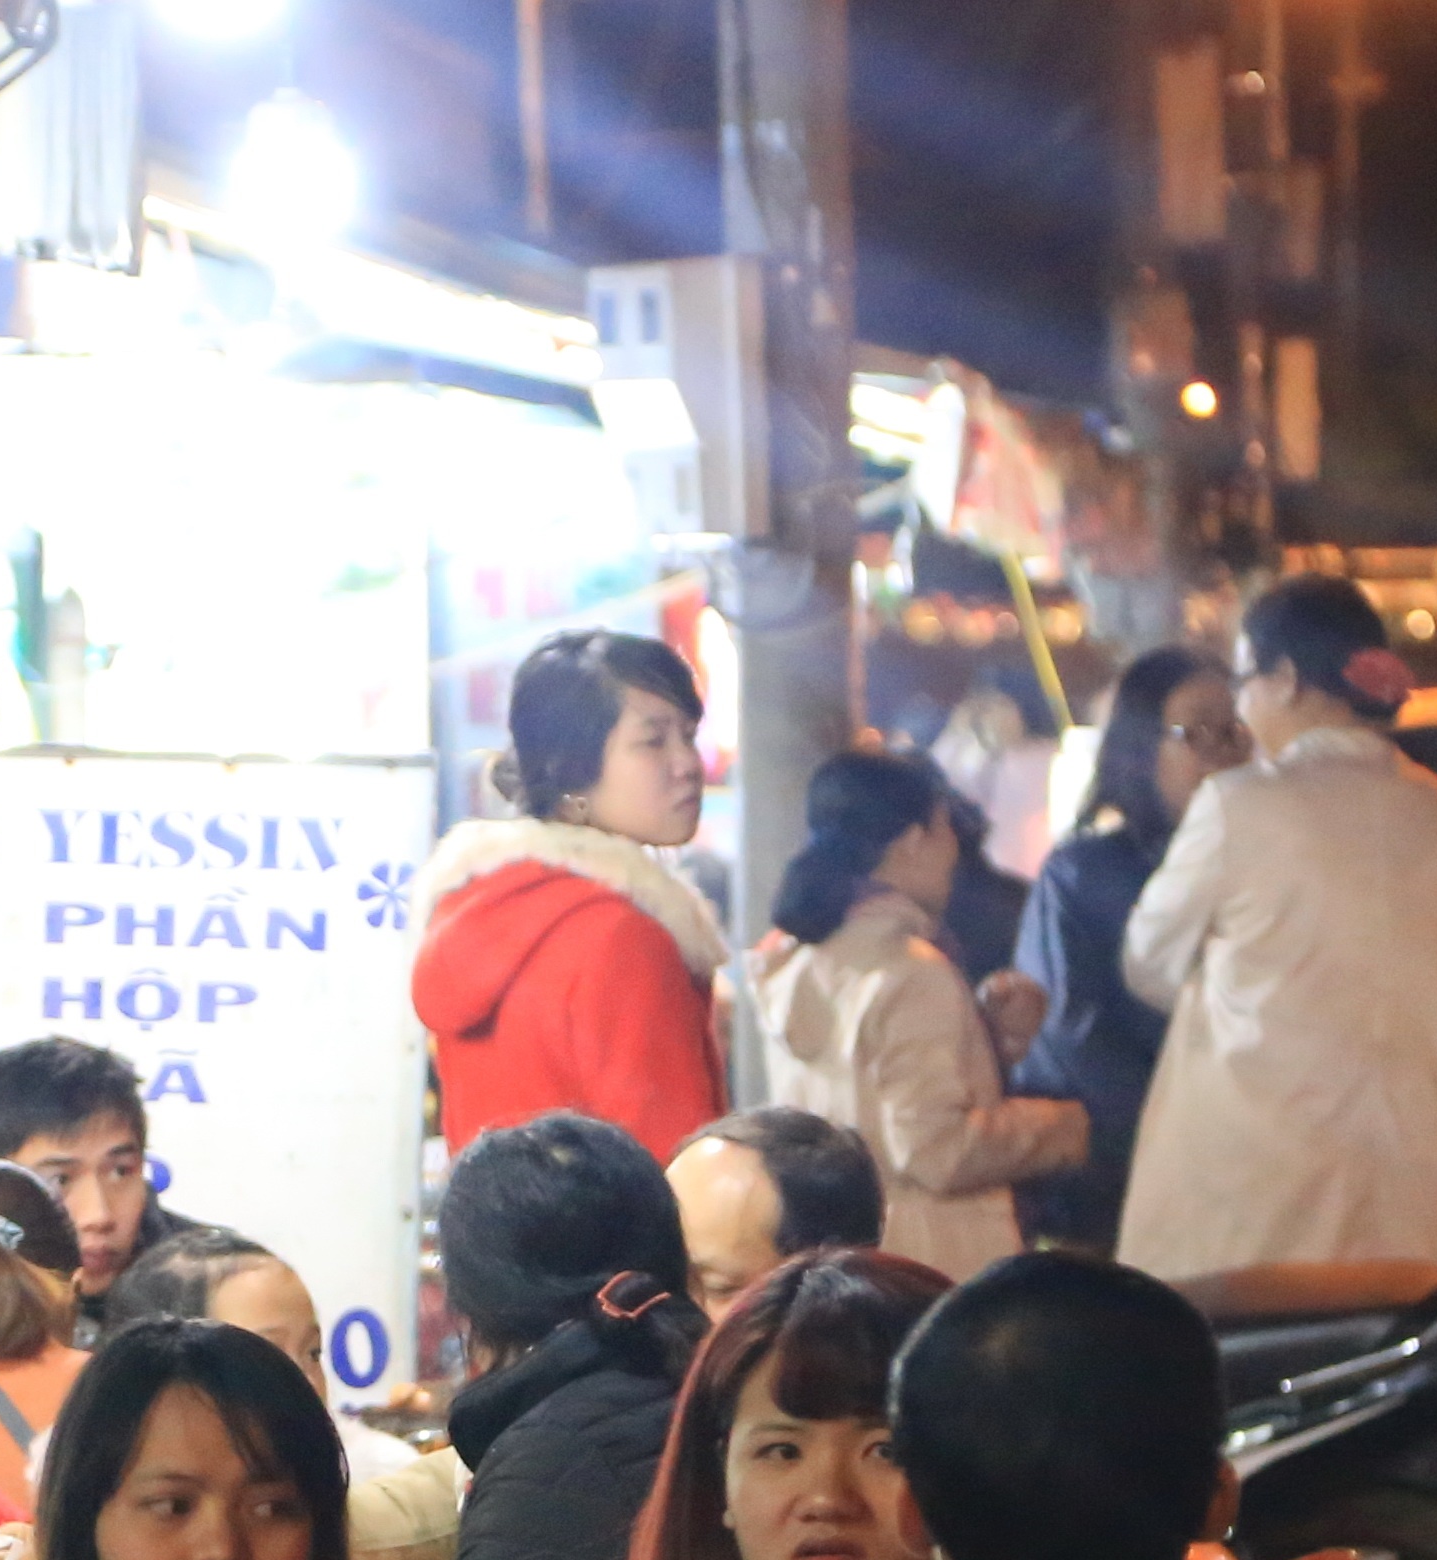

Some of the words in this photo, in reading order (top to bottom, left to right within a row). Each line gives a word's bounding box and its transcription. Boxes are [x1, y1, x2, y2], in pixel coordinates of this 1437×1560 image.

[43, 886, 328, 952] PHẦN
[42, 966, 259, 1031] HỘP
[145, 1048, 209, 1104] Ã
